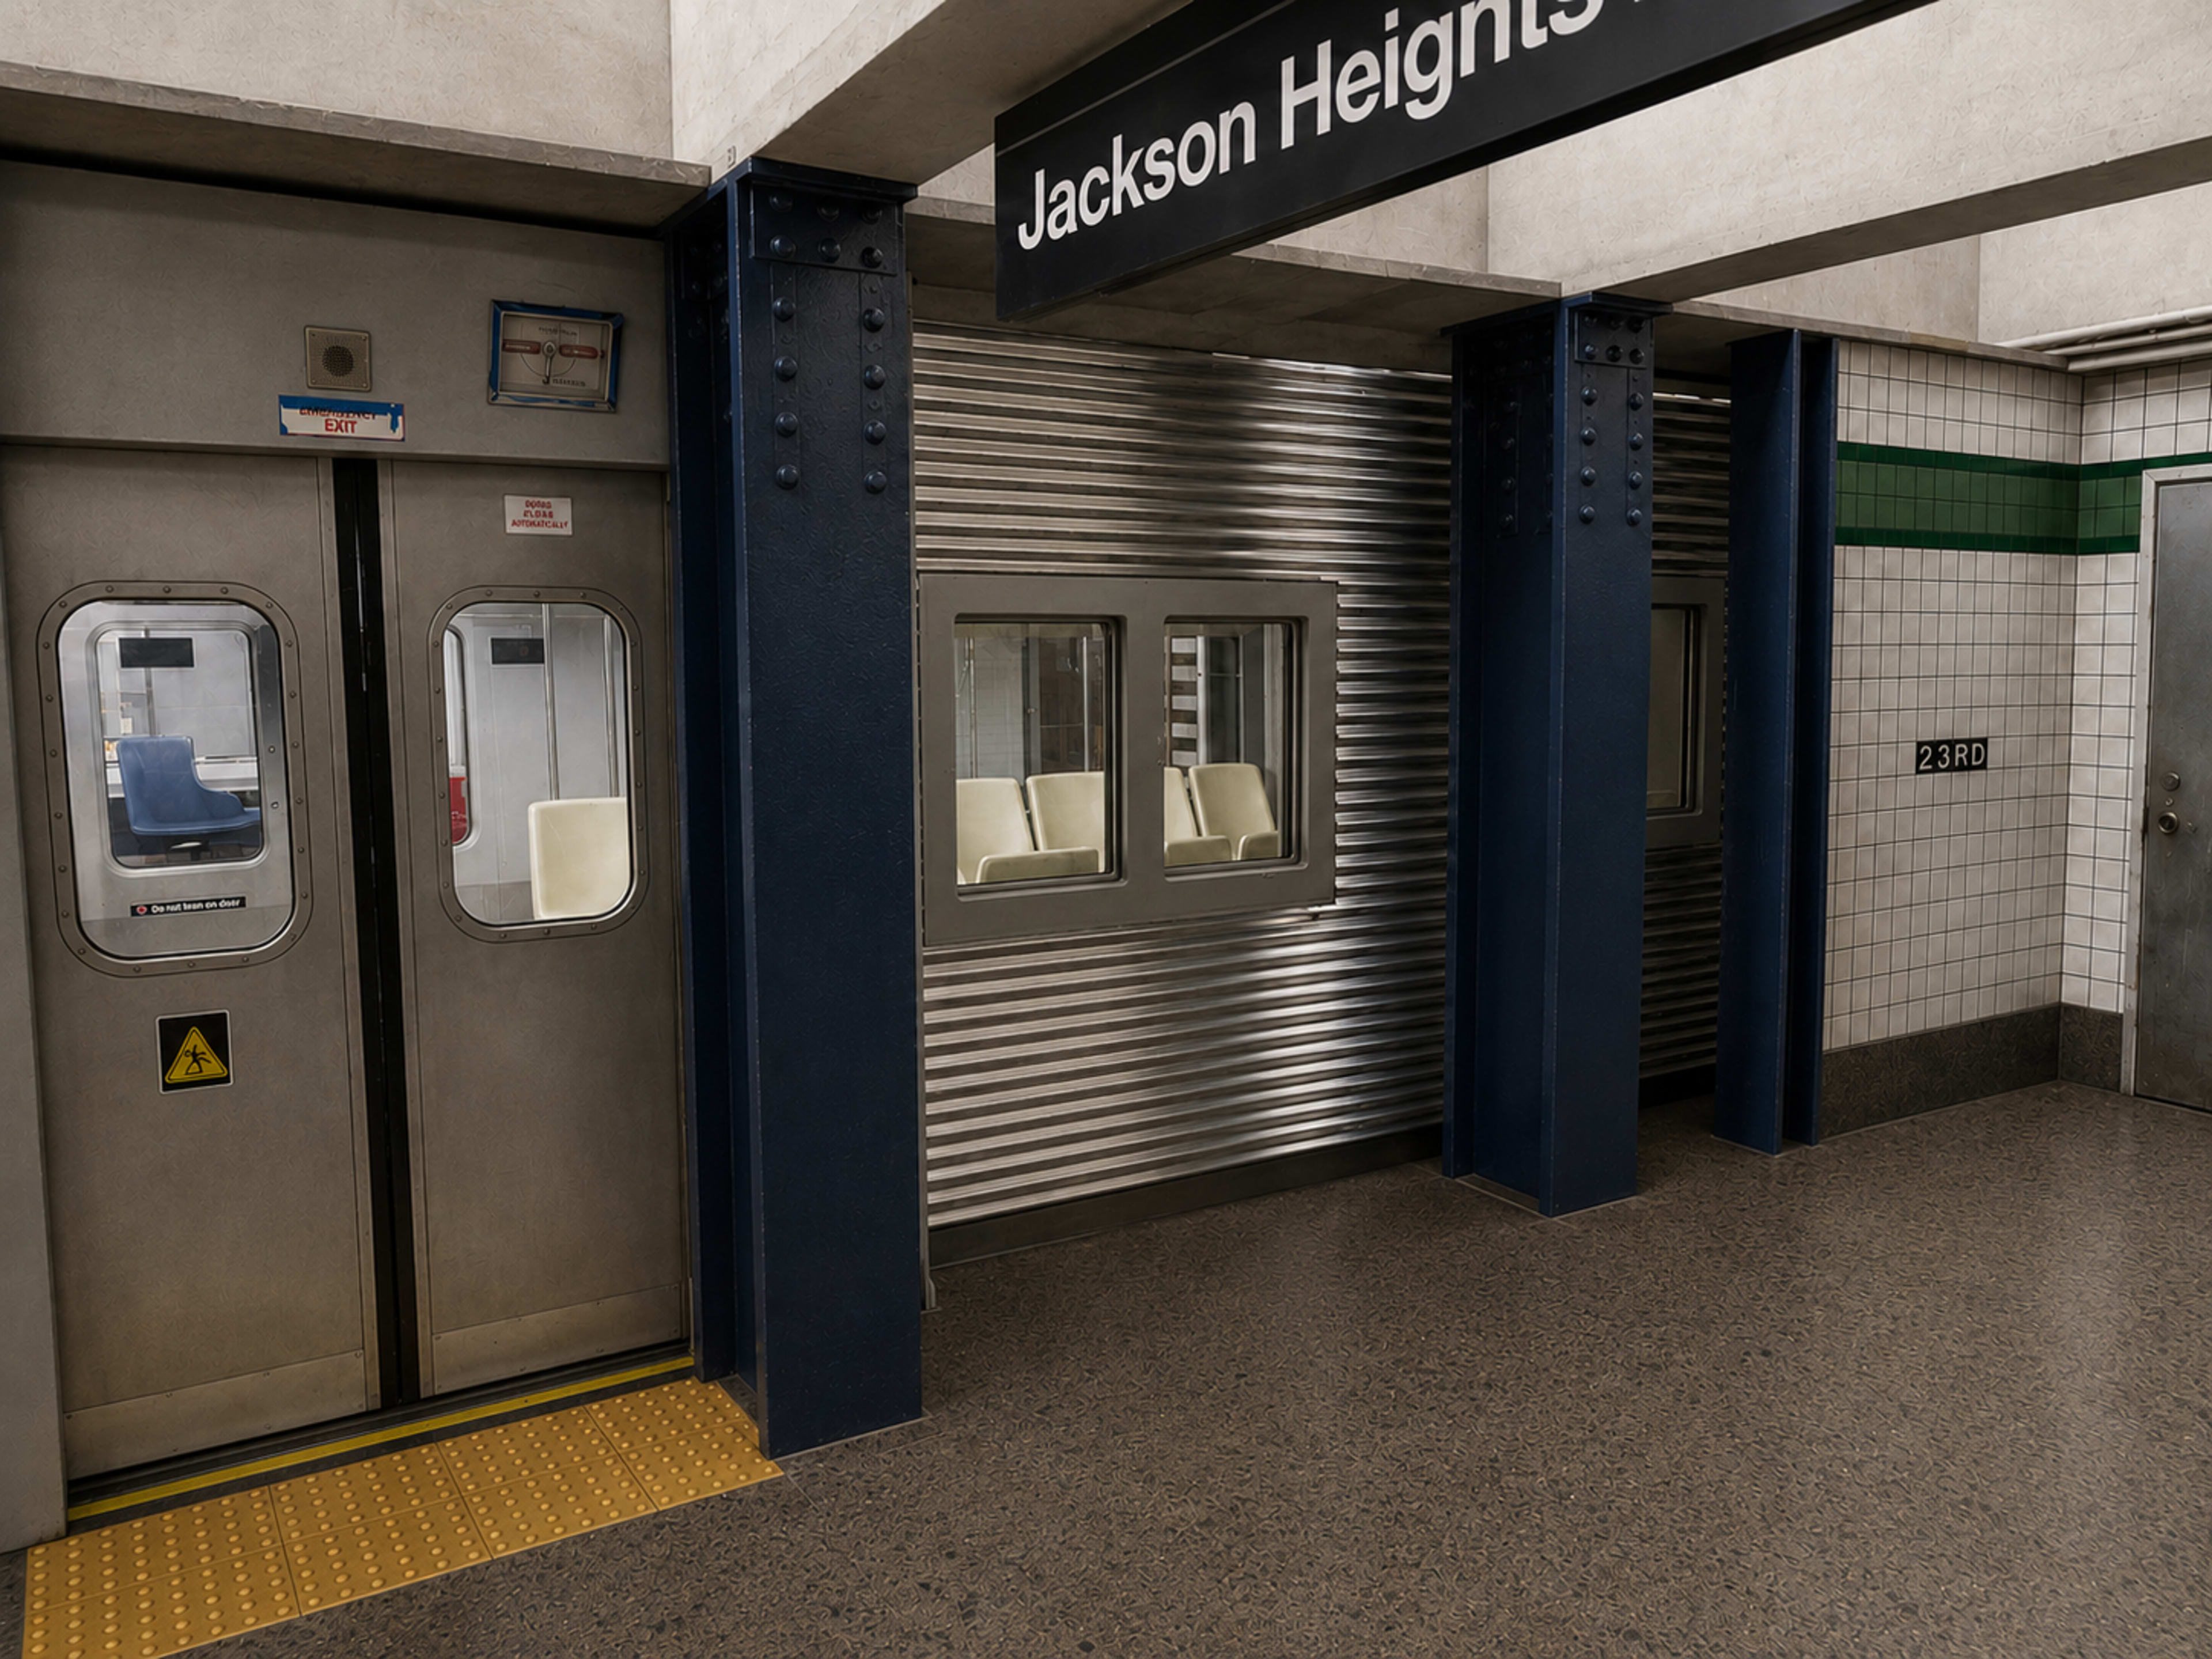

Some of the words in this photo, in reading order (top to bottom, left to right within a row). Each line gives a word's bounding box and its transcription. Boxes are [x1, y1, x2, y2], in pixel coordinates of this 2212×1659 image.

[1018, 101, 1256, 249] Jackson
[324, 418, 357, 433] EXIT
[1919, 743, 1985, 770] 23RD
